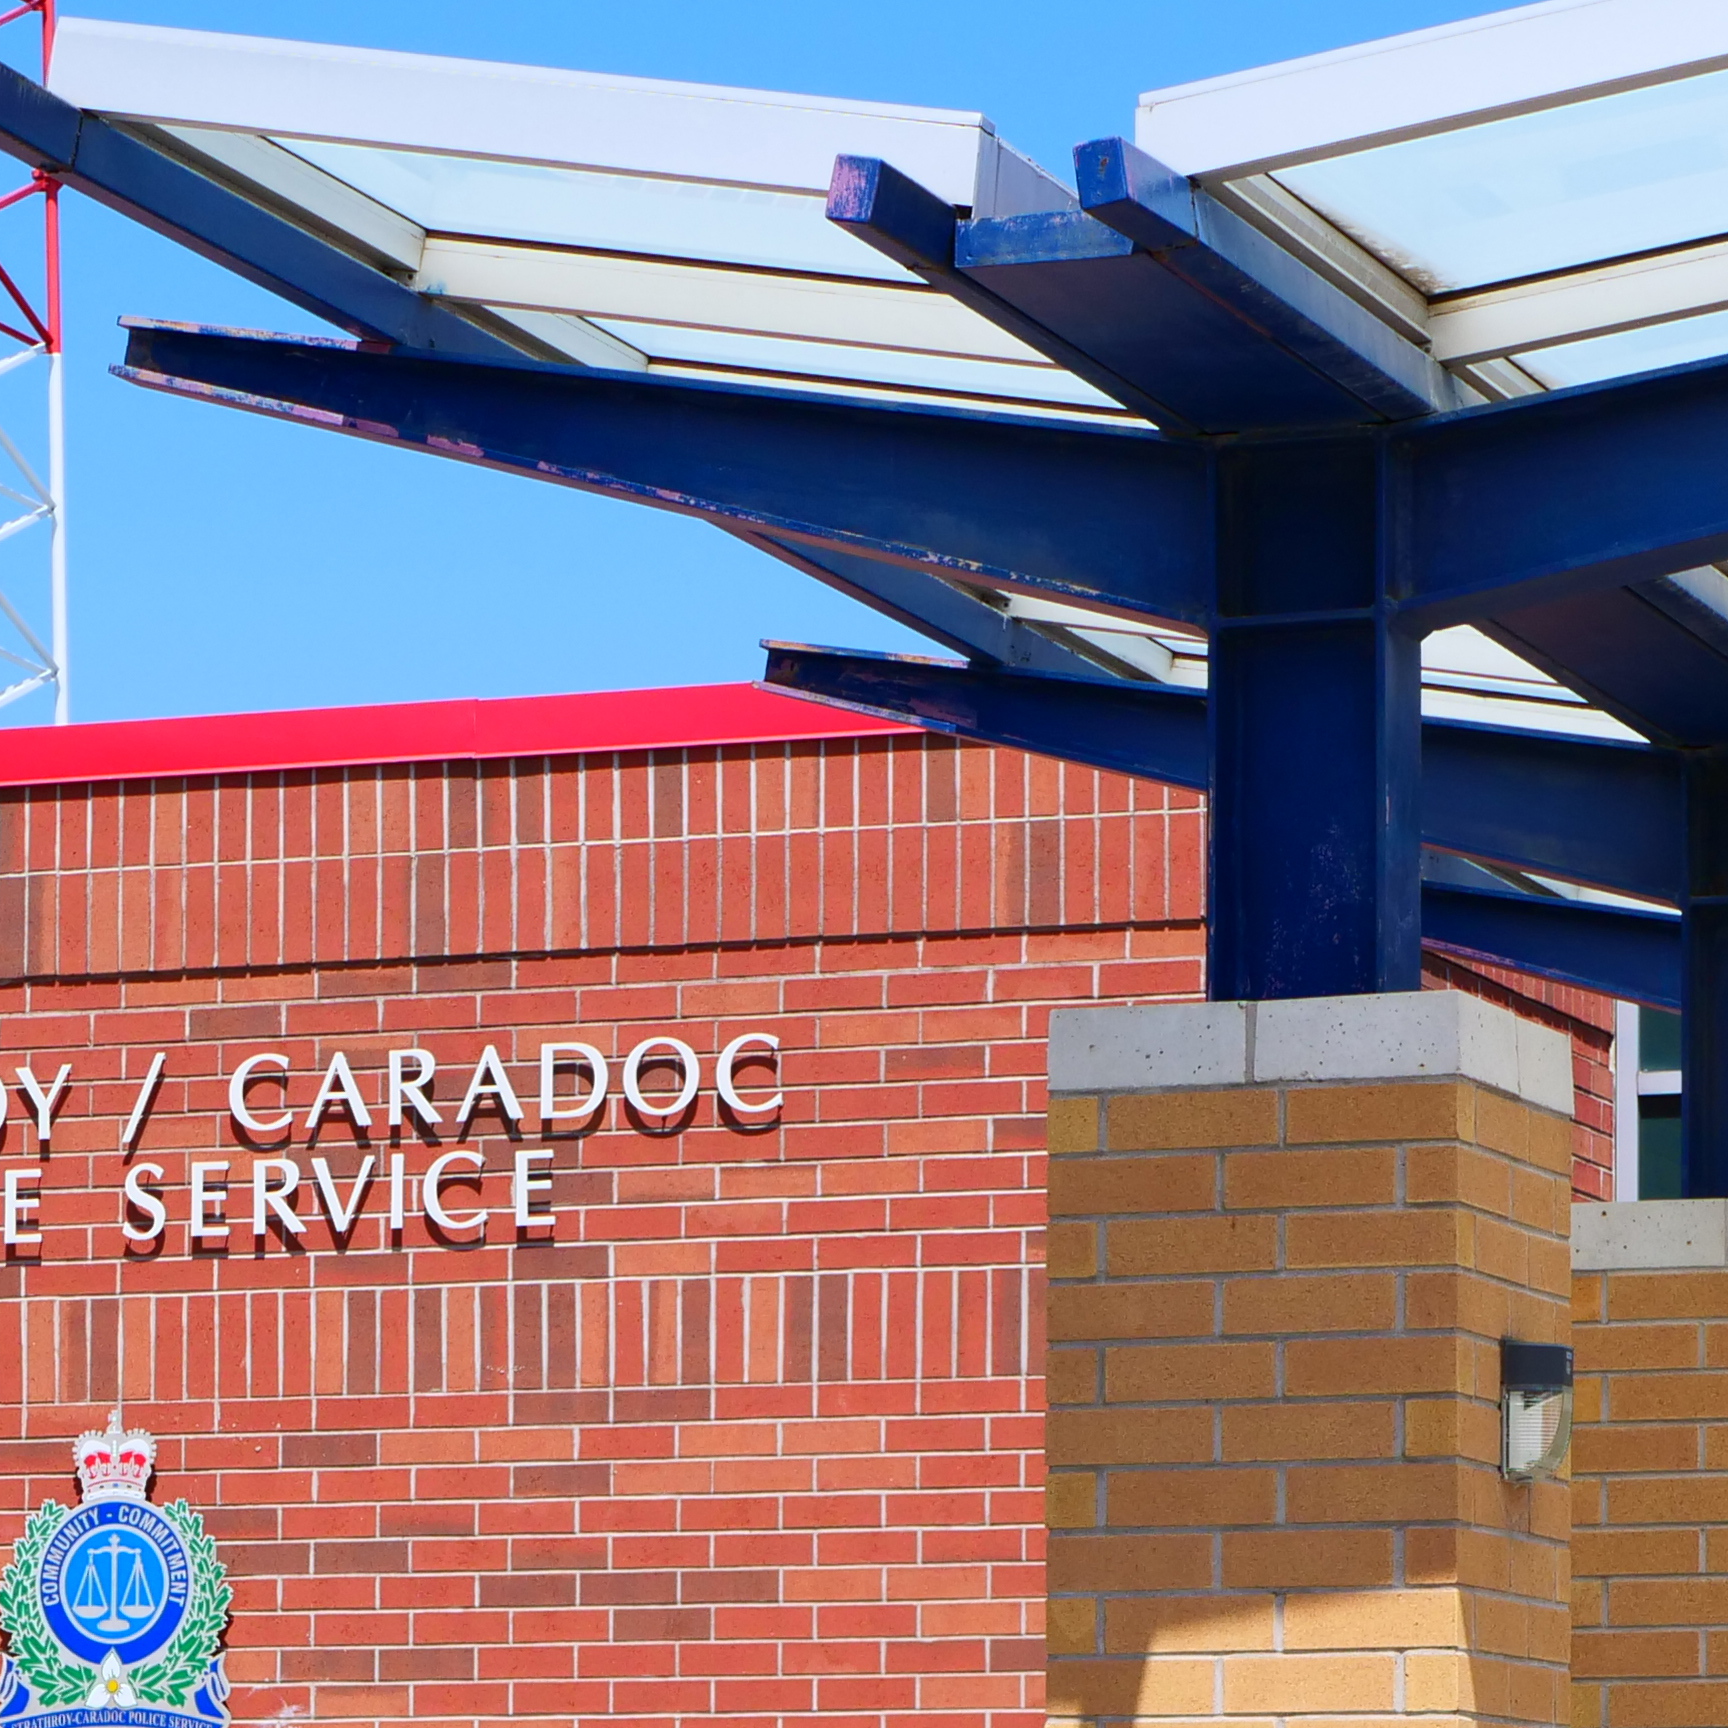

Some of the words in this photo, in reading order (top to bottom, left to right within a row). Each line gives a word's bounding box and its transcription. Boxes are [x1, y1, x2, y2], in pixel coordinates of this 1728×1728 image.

[121, 1051, 166, 1144] /
[228, 1033, 784, 1132] CARADOC
[122, 1148, 556, 1241] SERVICE
[41, 1506, 100, 1607] COMMUNITY
[118, 1504, 187, 1608] COMMITMENT
[128, 1710, 167, 1728] POLICE
